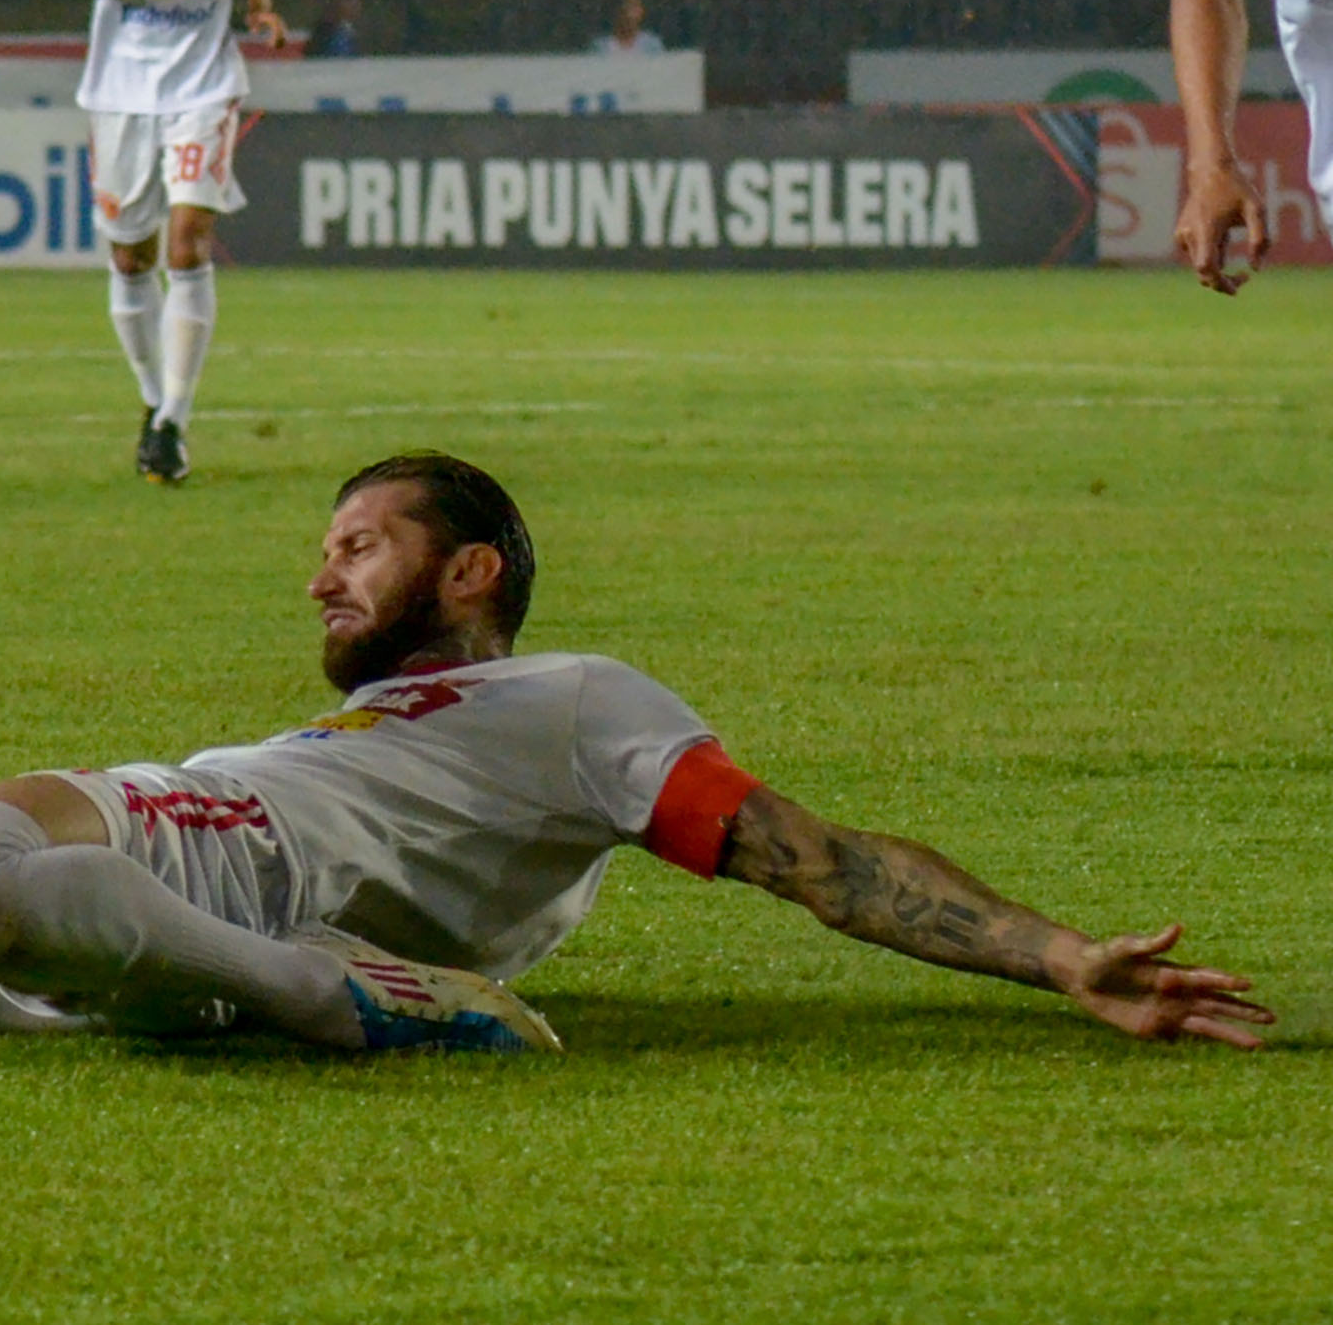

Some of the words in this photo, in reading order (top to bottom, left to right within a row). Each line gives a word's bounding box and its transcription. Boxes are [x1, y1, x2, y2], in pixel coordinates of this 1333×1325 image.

[300, 159, 476, 248] PRIA
[482, 159, 720, 248] PUNYA
[723, 159, 980, 248] SELERA
